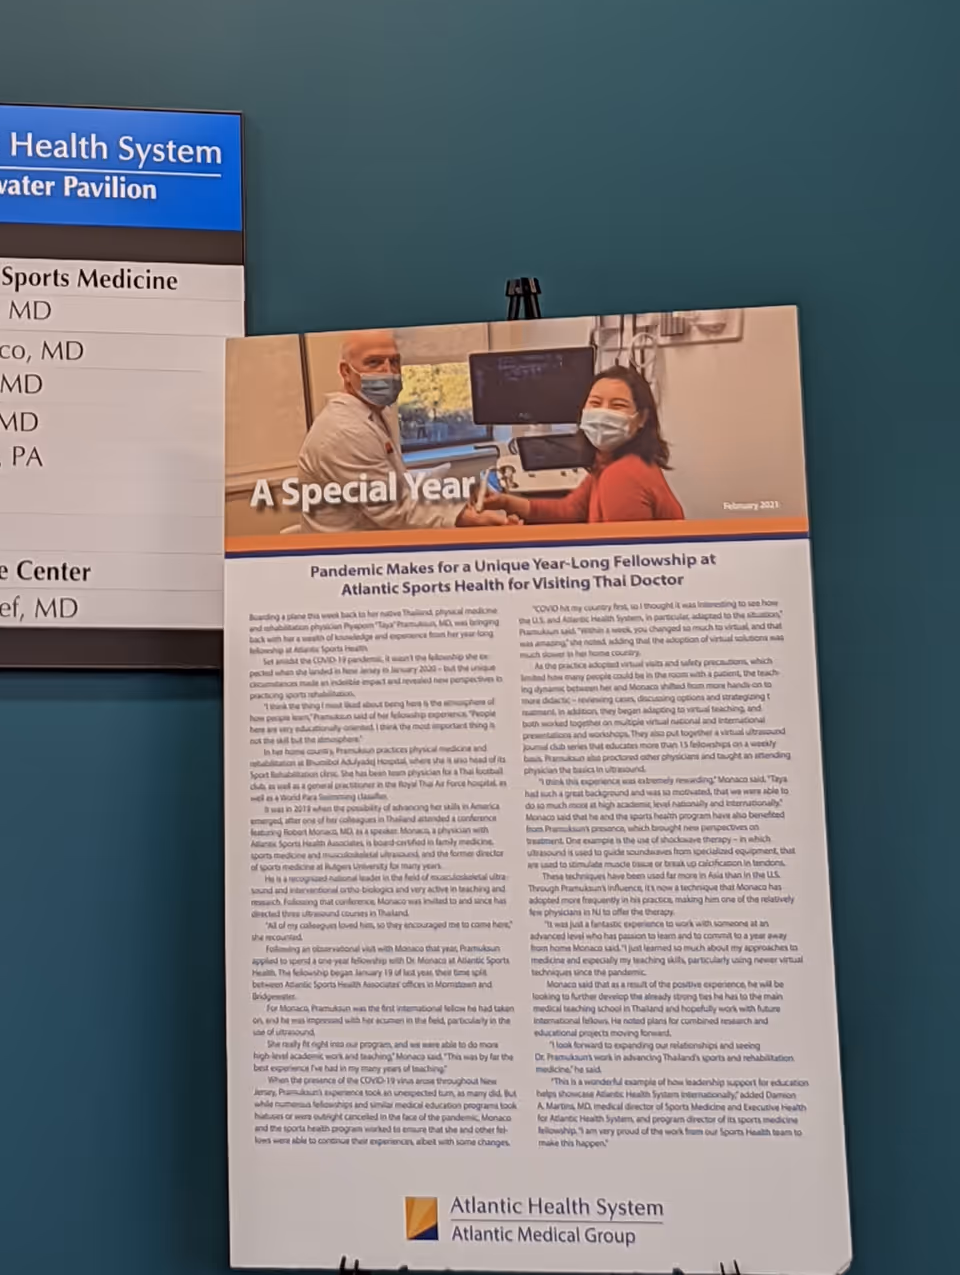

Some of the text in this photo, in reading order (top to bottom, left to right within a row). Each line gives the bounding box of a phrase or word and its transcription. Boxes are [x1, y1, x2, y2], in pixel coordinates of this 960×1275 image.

[10, 132, 109, 160] Health
[118, 136, 223, 169] System
[63, 175, 157, 200] Pavilion
[1, 266, 70, 292] Sports
[77, 268, 179, 291] Medicine
[8, 300, 52, 322] MD
[40, 340, 85, 362] MD
[0, 373, 43, 395] MD
[12, 447, 44, 467] PA
[250, 471, 476, 514] A Special Year
[723, 500, 780, 512] February 2021
[17, 560, 92, 583] Center
[310, 552, 716, 579] Pandemic Makes for a Unique Year-Long Fellowship at
[341, 571, 684, 598] Atlantic Sports Health for Visiting Thai Doctor
[34, 597, 78, 619] MD
[450, 1196, 664, 1221] Atlantic Health System
[451, 1225, 636, 1248] Atlantic Medical Group
